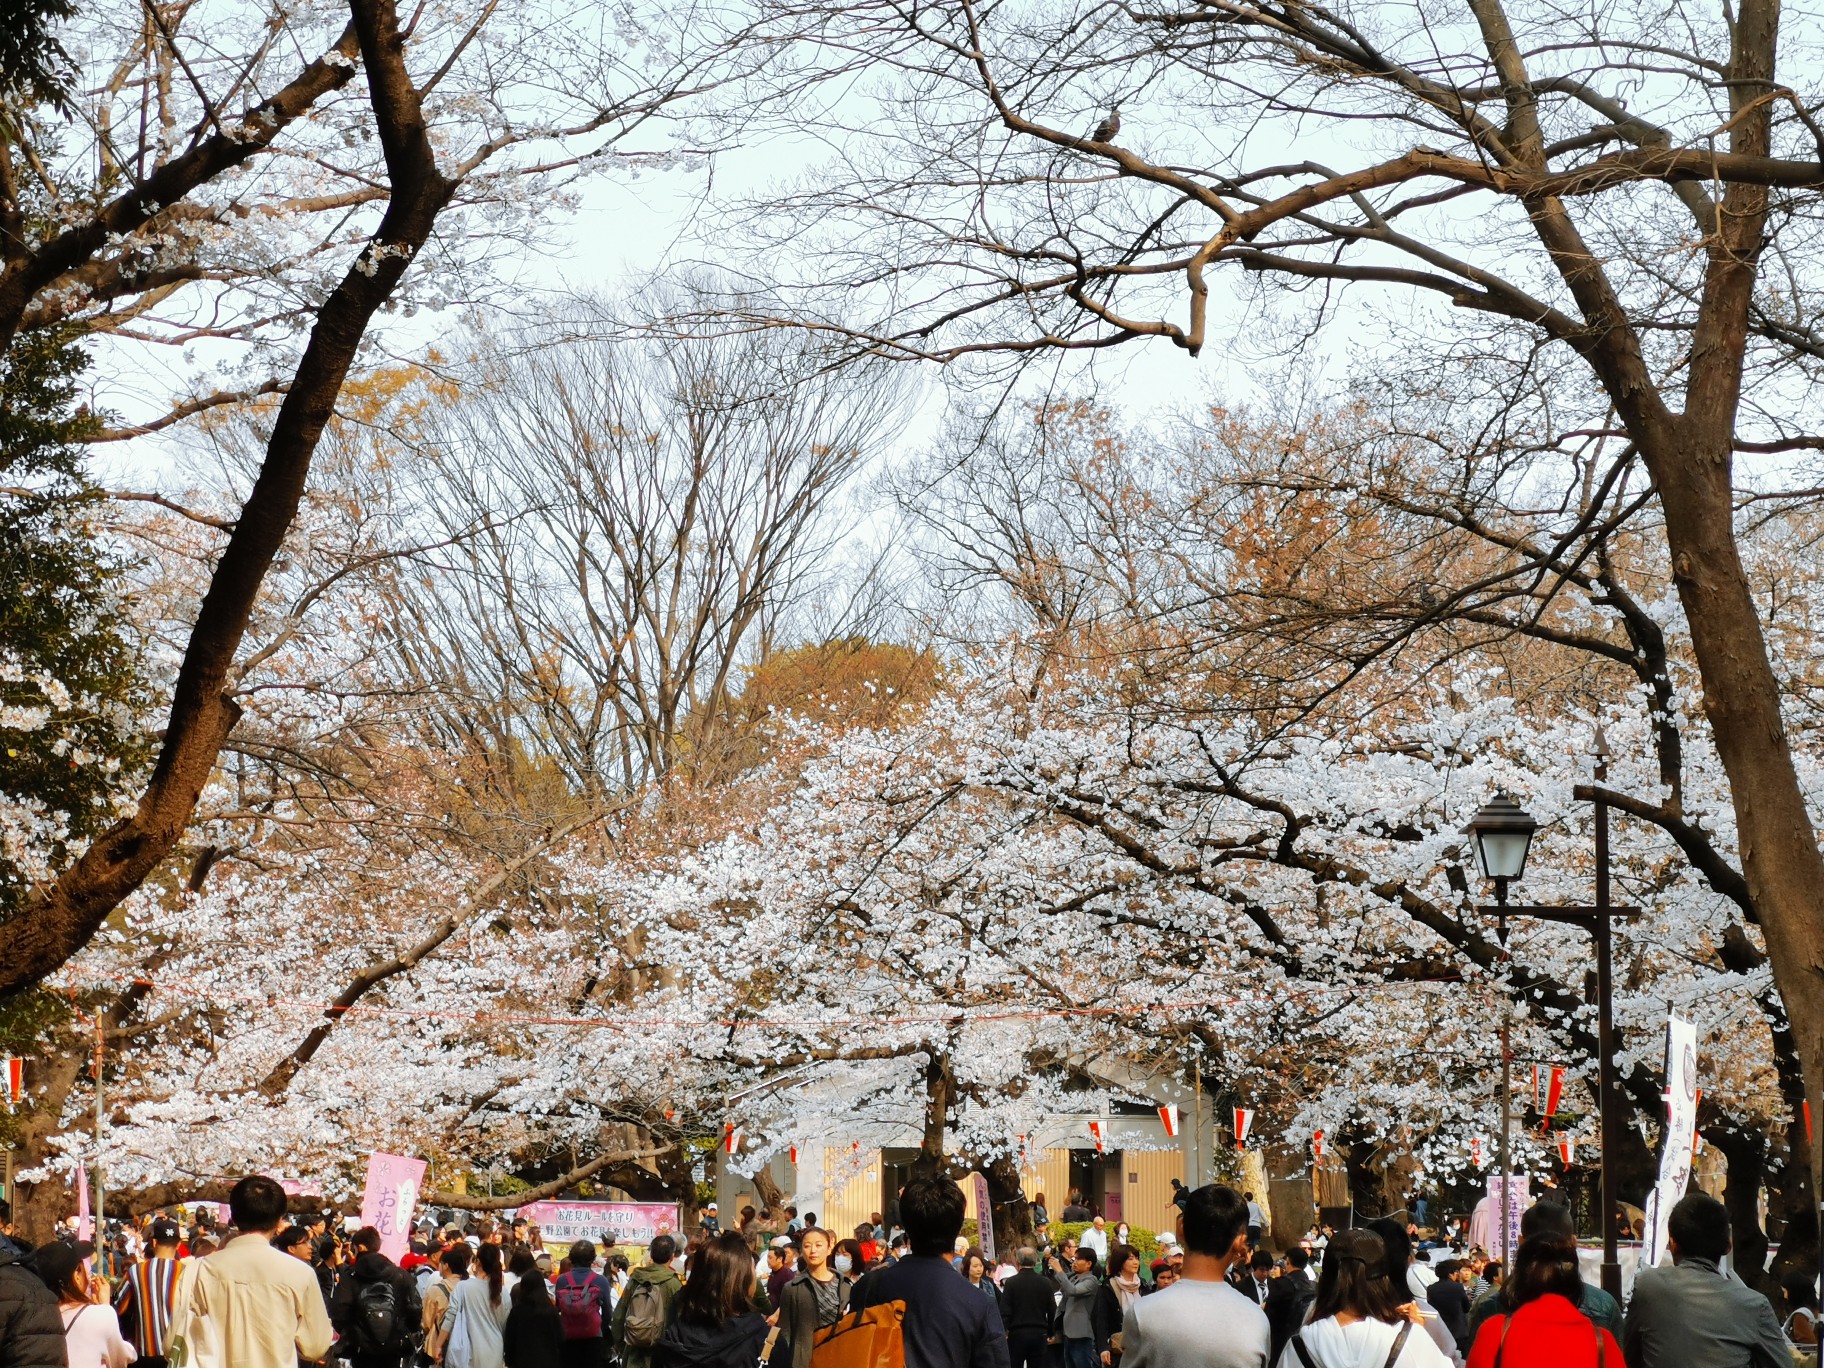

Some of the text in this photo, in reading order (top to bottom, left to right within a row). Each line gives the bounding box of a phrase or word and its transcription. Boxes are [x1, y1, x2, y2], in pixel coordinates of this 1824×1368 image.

[558, 1210, 634, 1223] お花見ルールを守り
